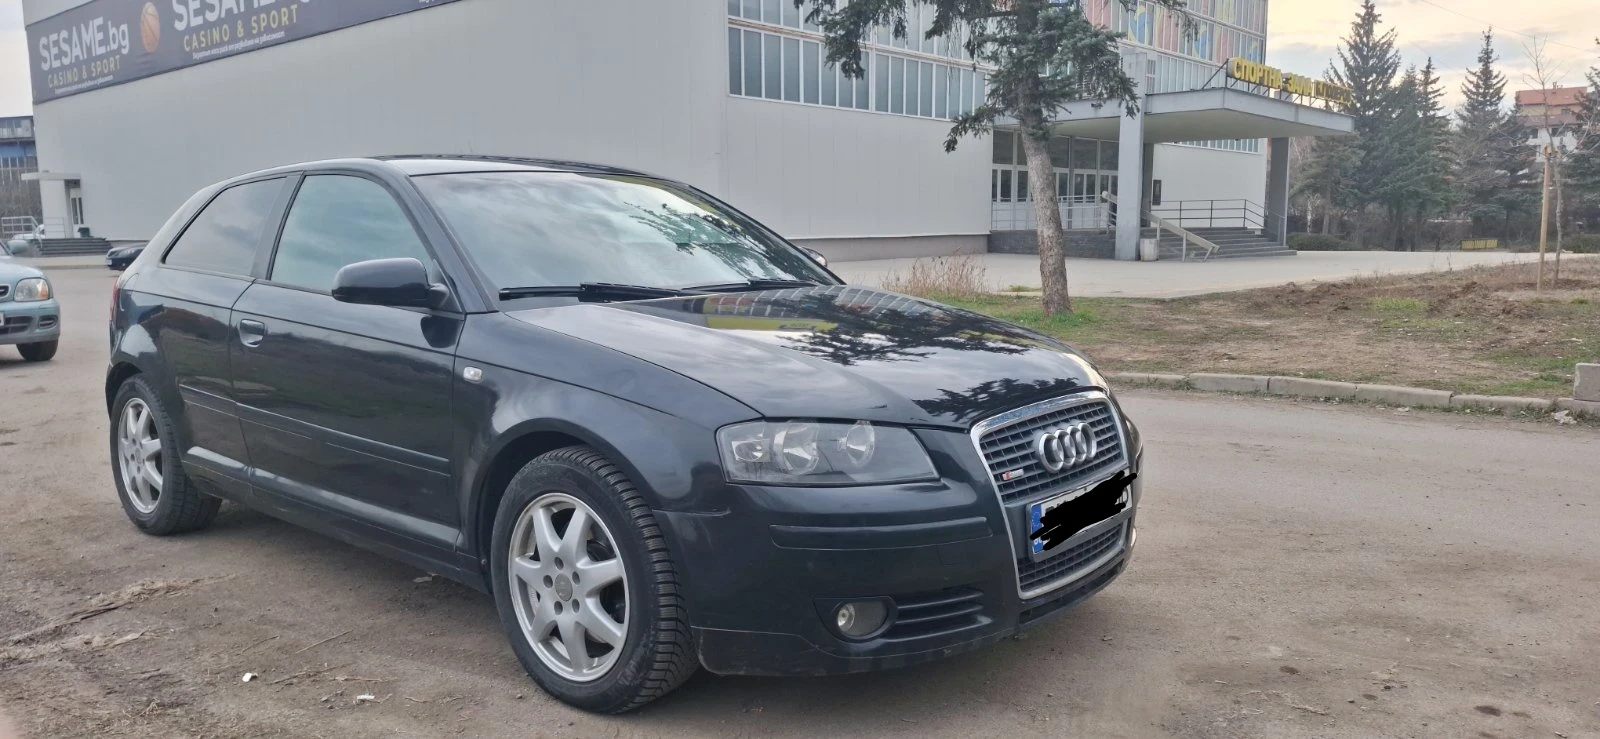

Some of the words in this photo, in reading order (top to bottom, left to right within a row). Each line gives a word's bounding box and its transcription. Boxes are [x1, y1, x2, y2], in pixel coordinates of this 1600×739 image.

[39, 16, 130, 71] SESAME.bg
[183, 24, 230, 52] CASINO
[236, 20, 244, 38] &
[251, 4, 298, 34] SPORT
[47, 67, 79, 89] CASINO
[91, 55, 121, 78] SPORT
[1233, 58, 1283, 89] СПОРТНА
